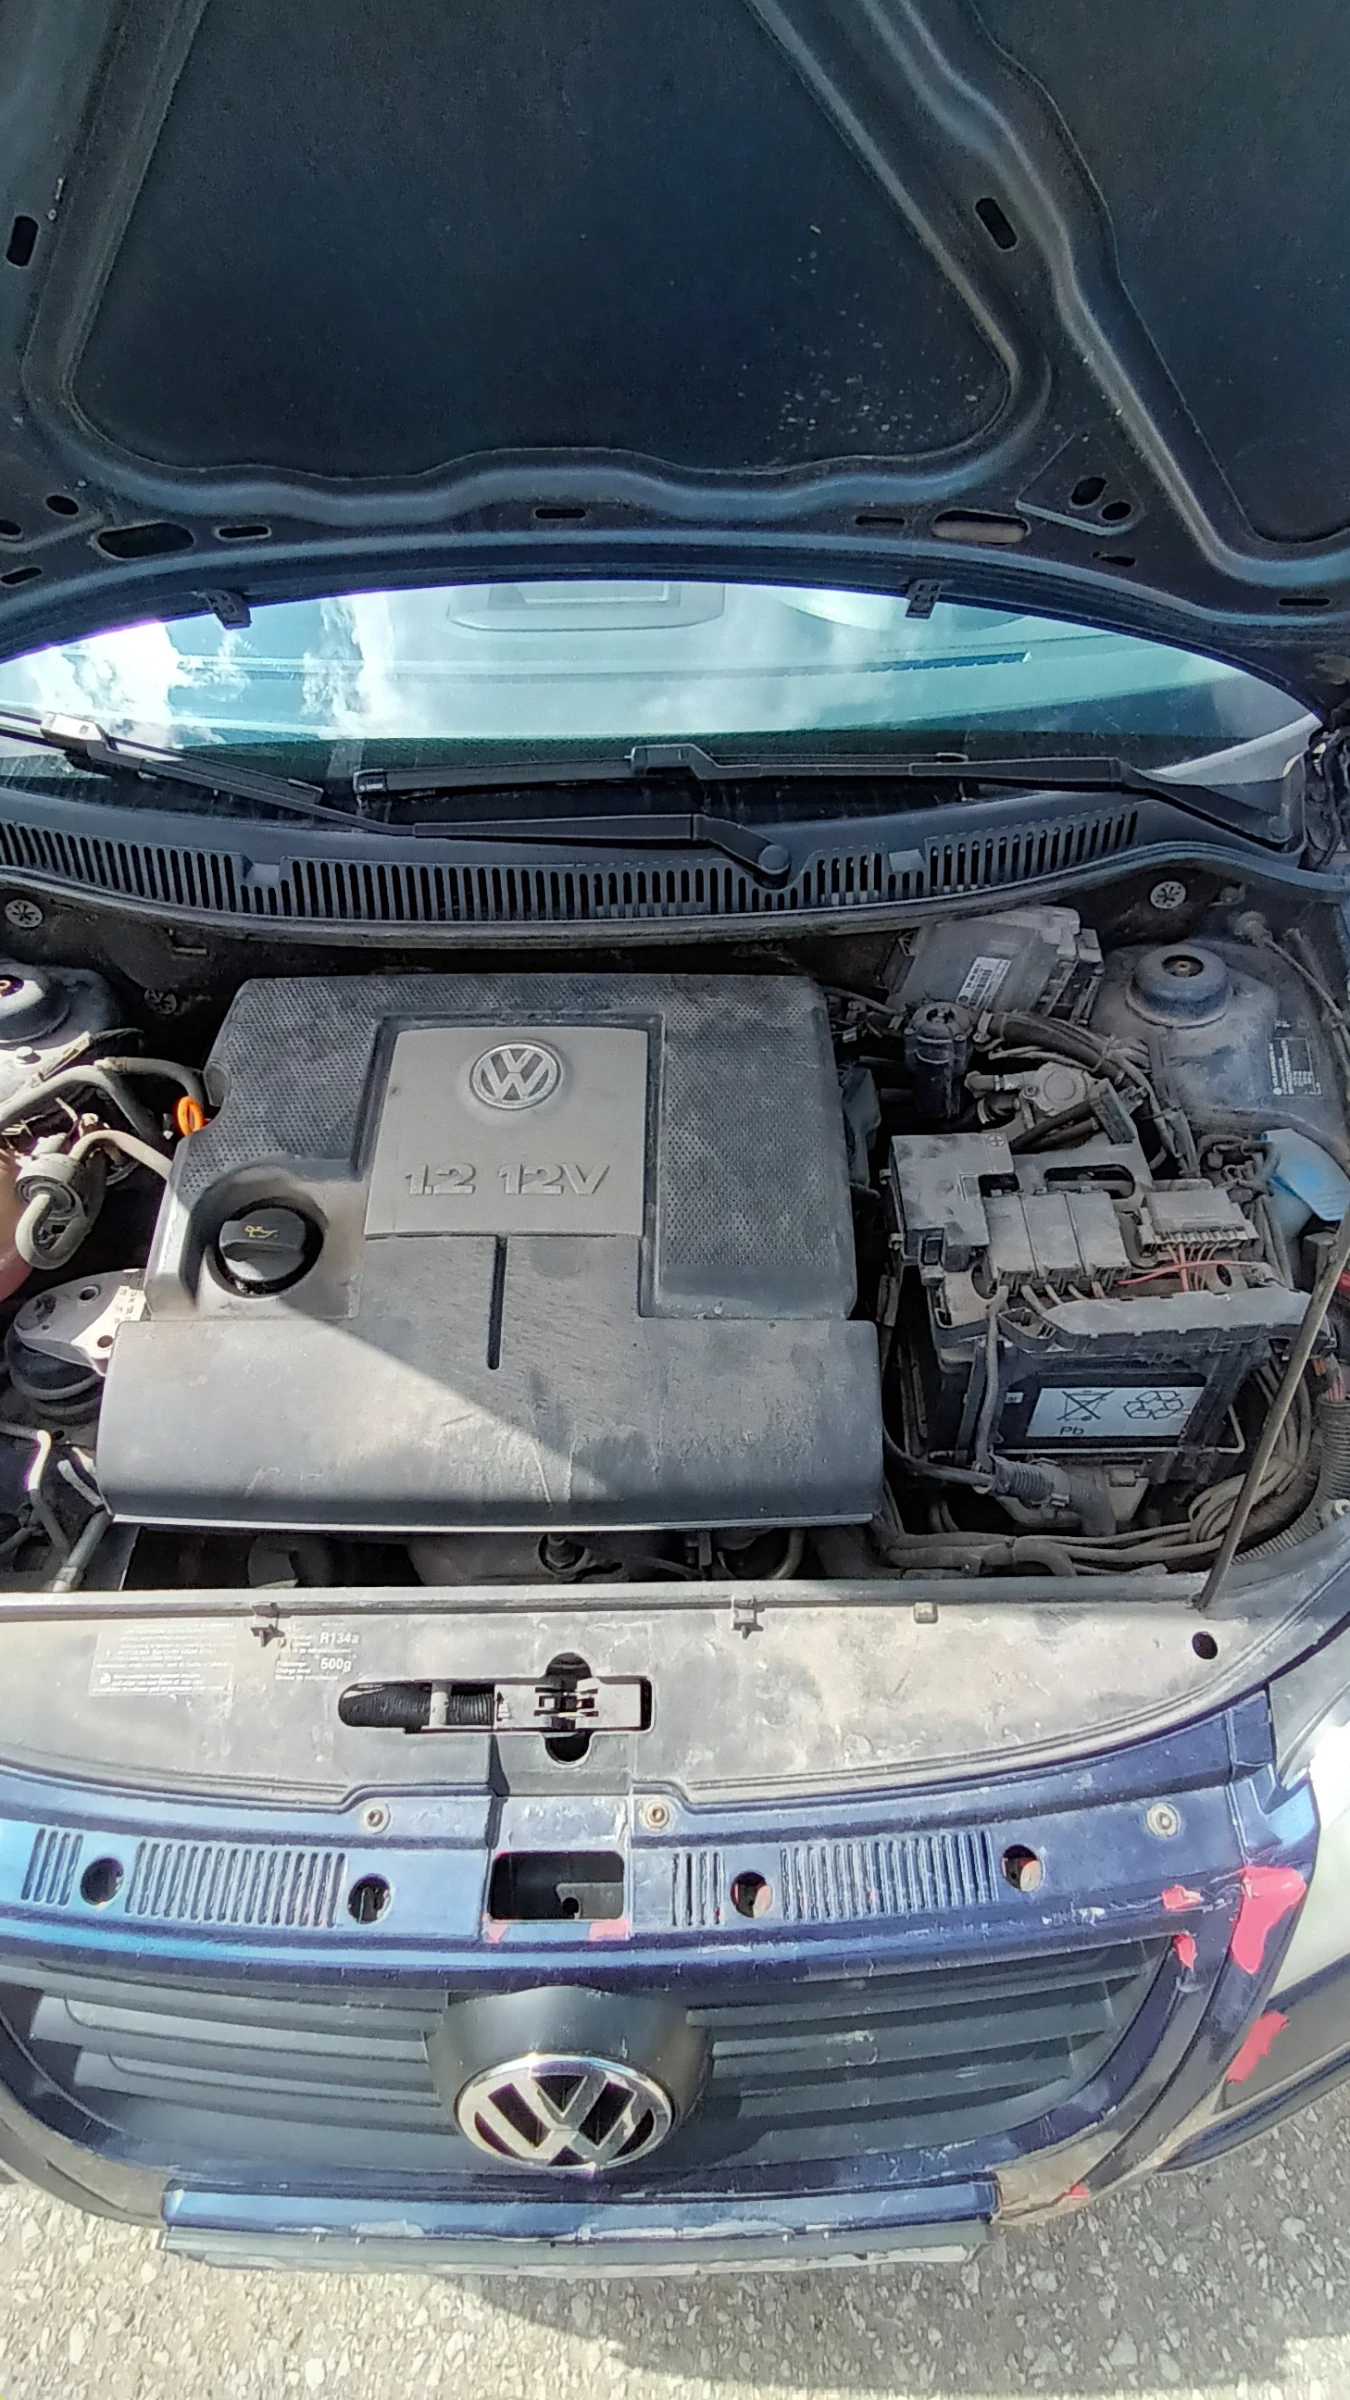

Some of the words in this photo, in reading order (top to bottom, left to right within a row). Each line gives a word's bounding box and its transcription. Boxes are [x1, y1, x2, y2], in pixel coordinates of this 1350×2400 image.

[405, 1163, 476, 1195] 1.2
[499, 1163, 610, 1196] 12V
[1060, 1426, 1085, 1435] Pb
[320, 1632, 359, 1644] R134a
[321, 1657, 352, 1673] 500g
